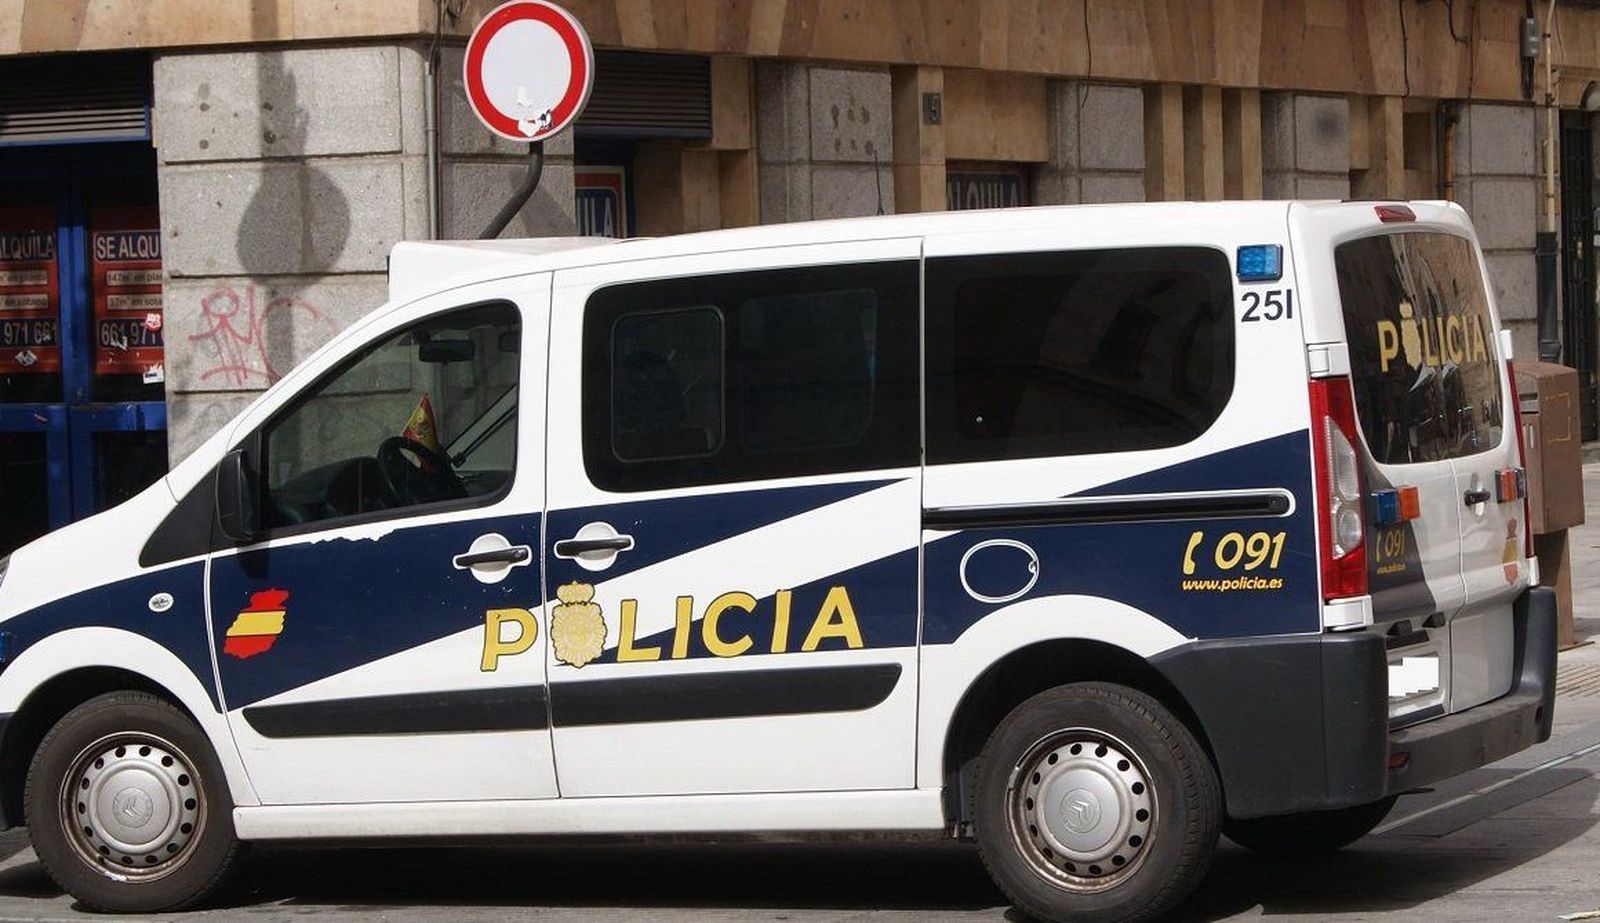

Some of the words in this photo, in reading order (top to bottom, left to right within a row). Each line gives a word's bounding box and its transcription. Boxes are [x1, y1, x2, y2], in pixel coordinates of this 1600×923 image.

[97, 235, 116, 259] SE
[3, 321, 29, 344] 971
[1214, 531, 1287, 571] 091
[1385, 528, 1405, 557] 091
[1182, 576, 1283, 592] www.policia.es
